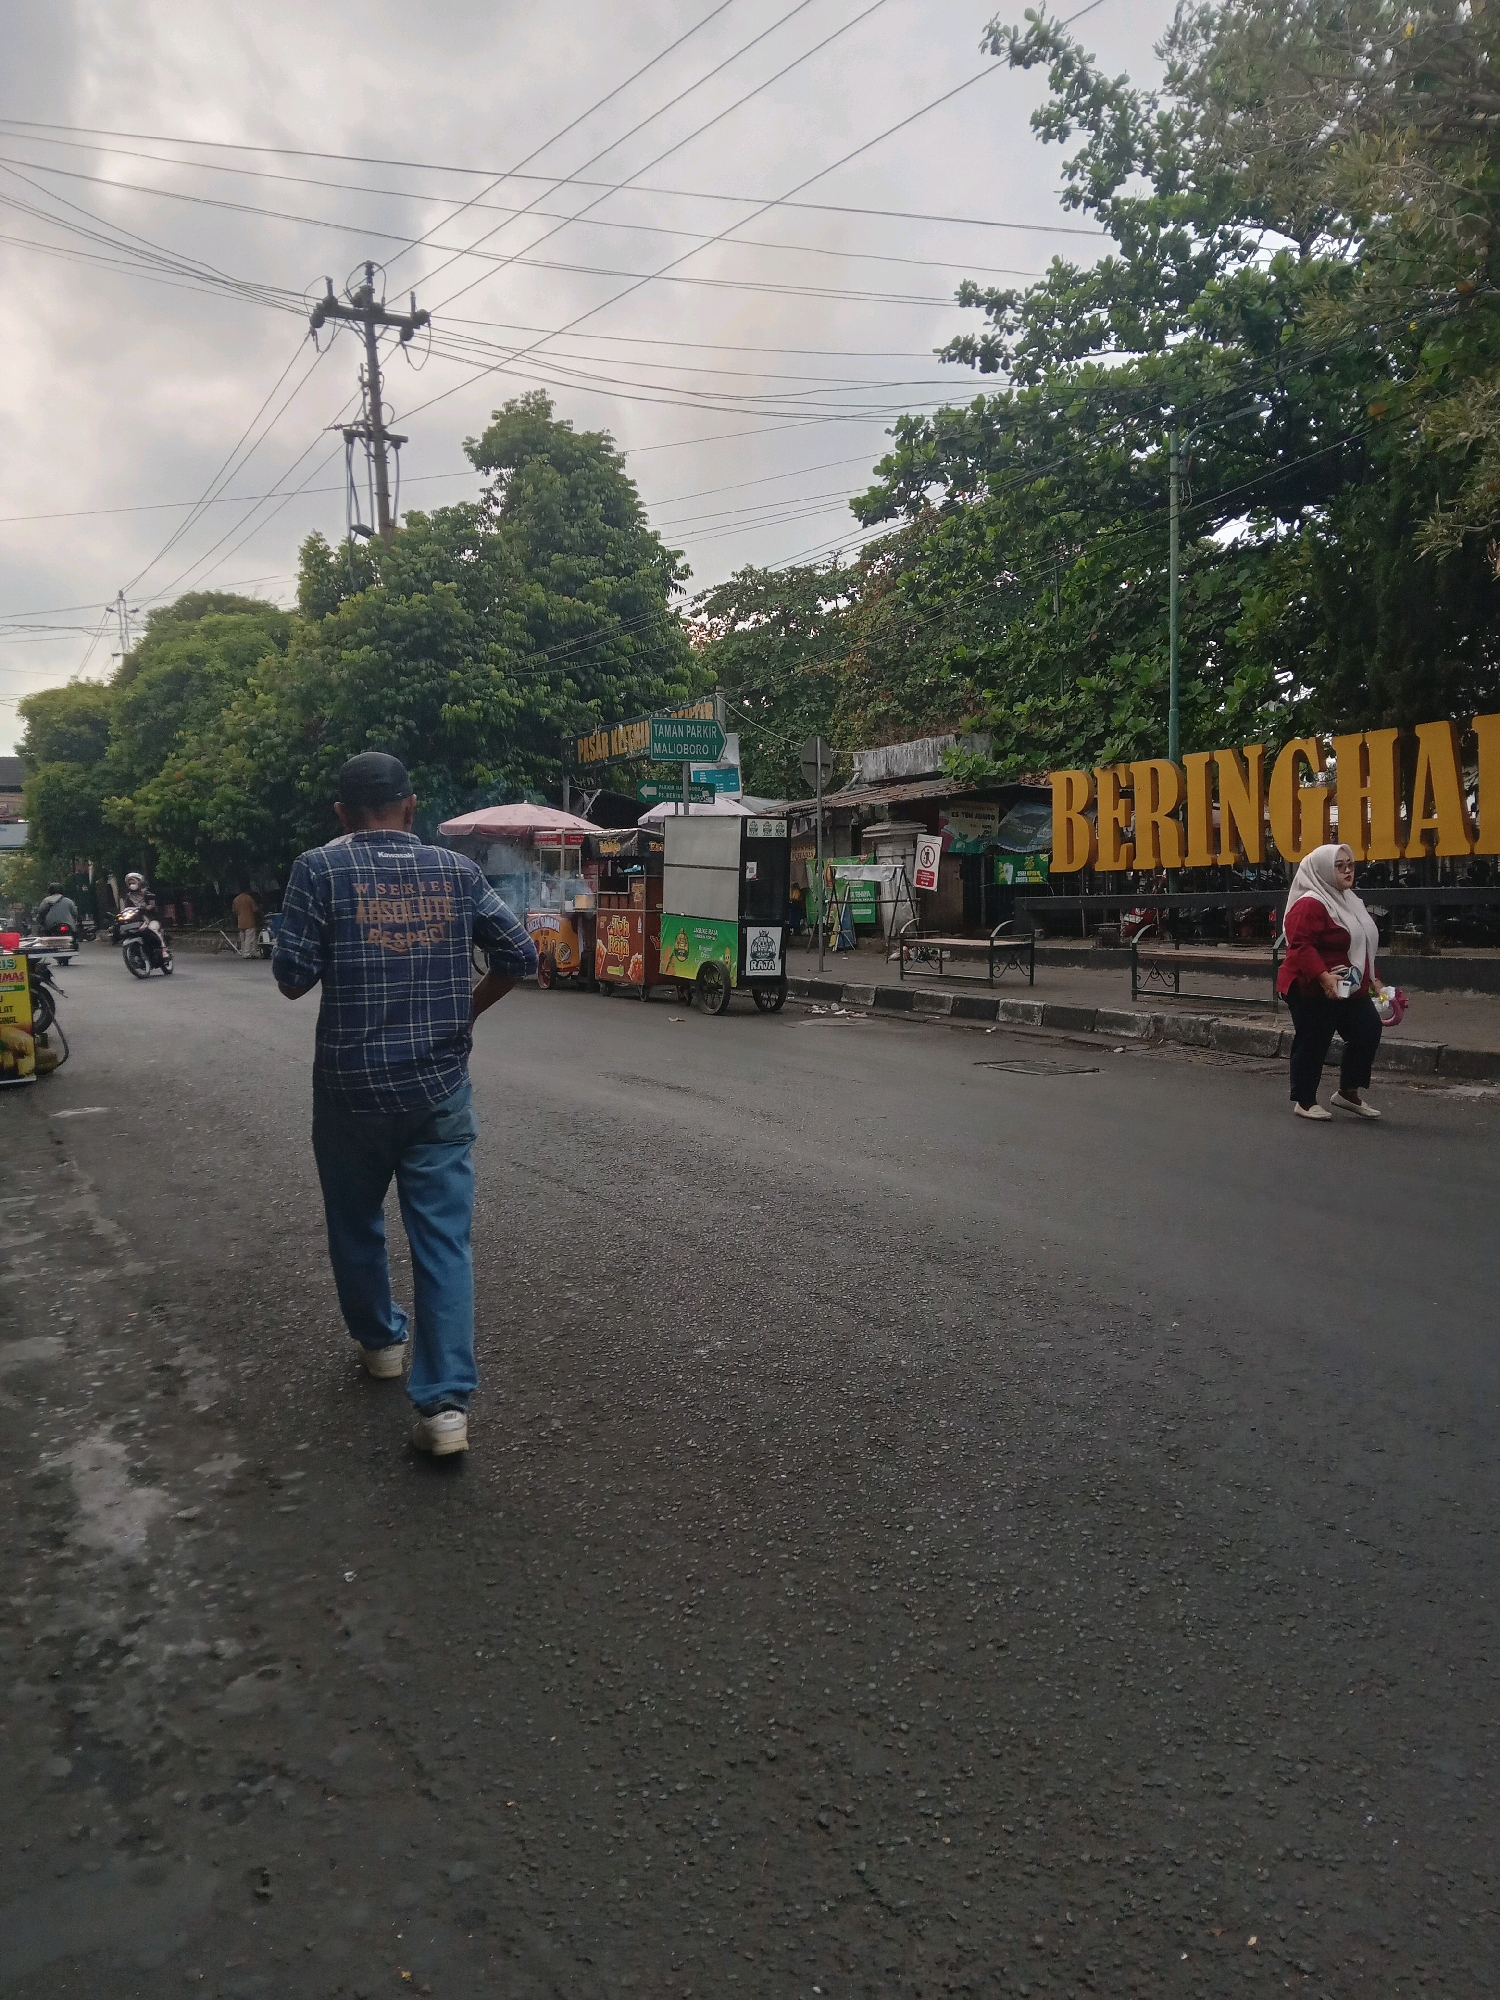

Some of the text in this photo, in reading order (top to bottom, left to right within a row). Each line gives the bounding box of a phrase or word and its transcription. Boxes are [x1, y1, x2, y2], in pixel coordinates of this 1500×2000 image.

[653, 723, 717, 739] TAMAN PARKIR
[577, 732, 610, 763] PASAR
[653, 743, 709, 755] MALIOBORO
[352, 881, 453, 895] W SERIES
[355, 896, 456, 924] ABSOLUTE
[367, 922, 446, 953] RESPECT
[607, 915, 630, 938] Teh
[607, 934, 630, 961] Raja
[750, 959, 775, 971] RAJA
